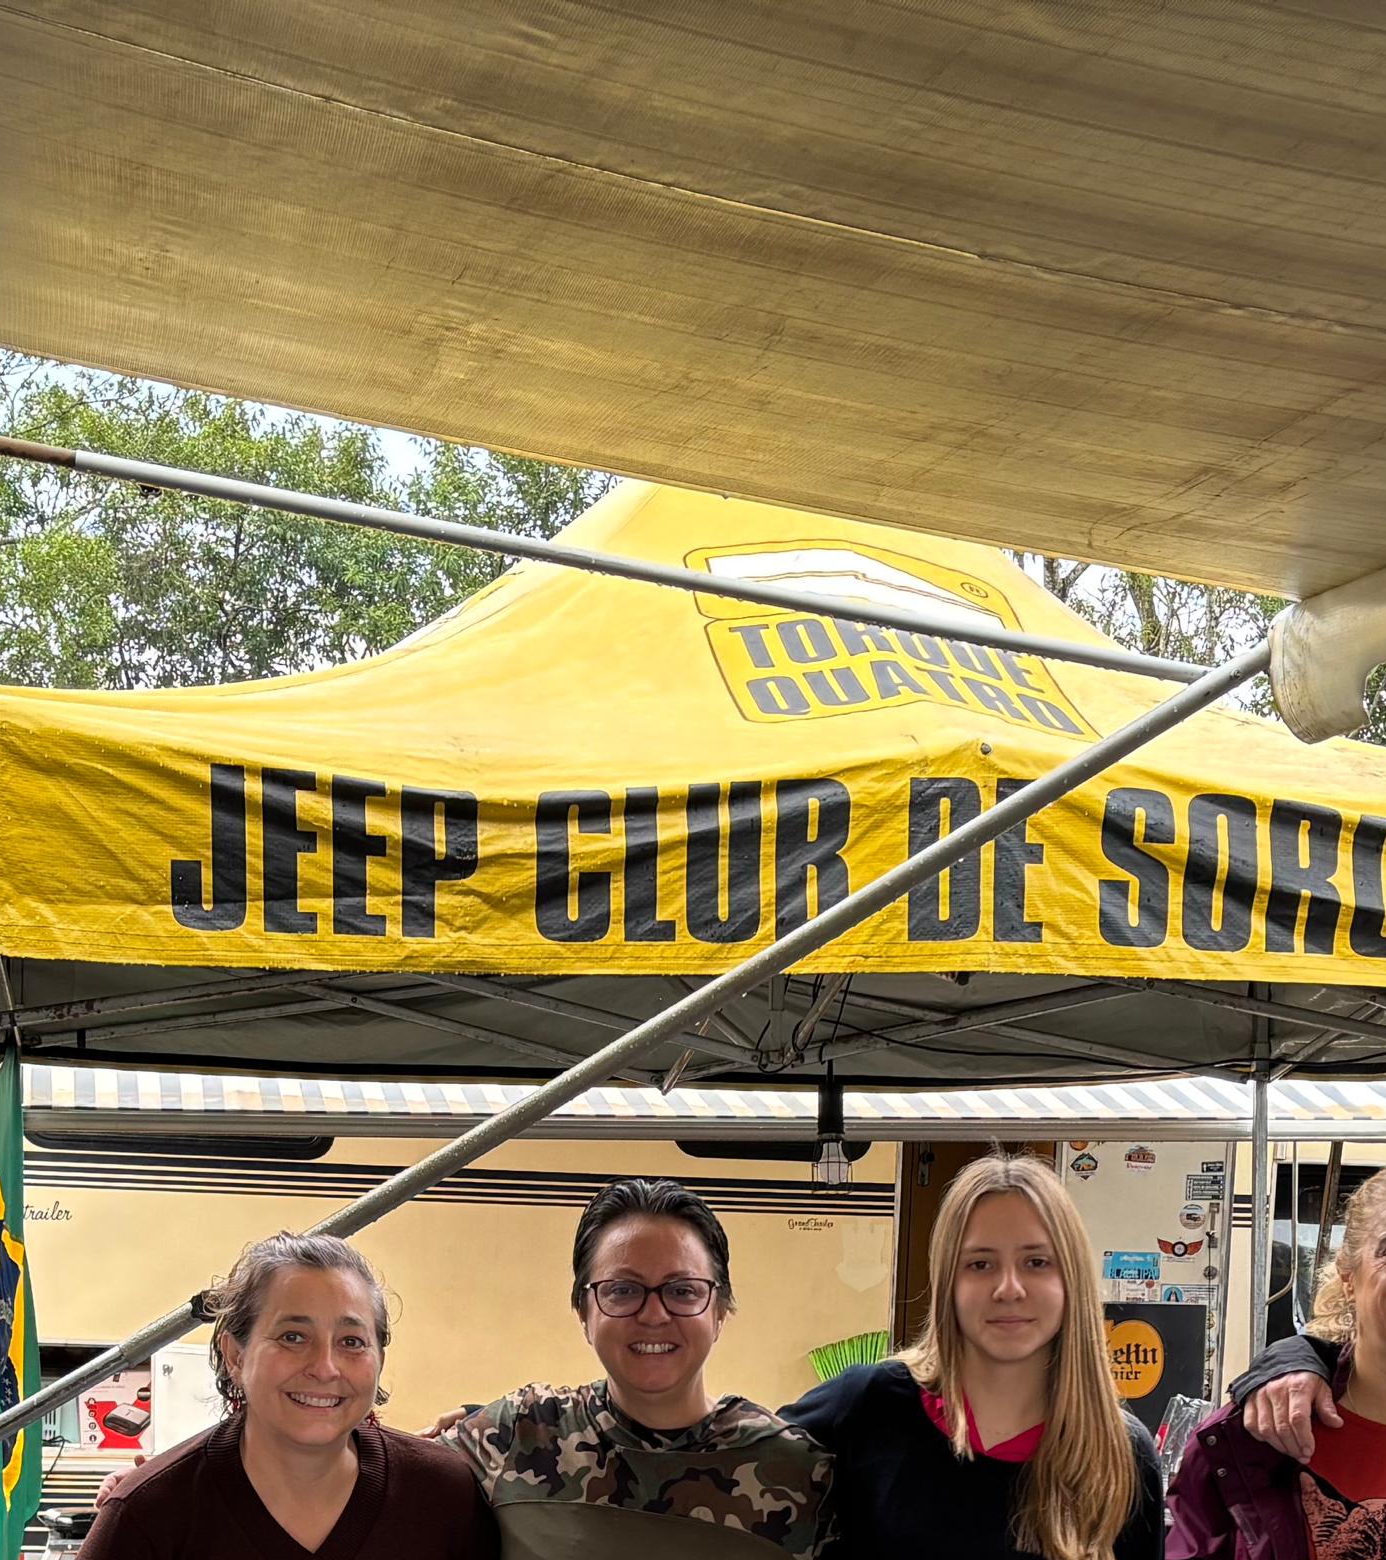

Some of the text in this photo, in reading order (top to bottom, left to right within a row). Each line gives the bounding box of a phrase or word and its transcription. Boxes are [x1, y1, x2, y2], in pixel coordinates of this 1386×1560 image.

[728, 617, 1044, 694] TORQUE
[746, 659, 1085, 735] QUATRO
[171, 764, 478, 937] JEEP
[535, 778, 851, 943] CLUB
[909, 777, 1044, 942] DE
